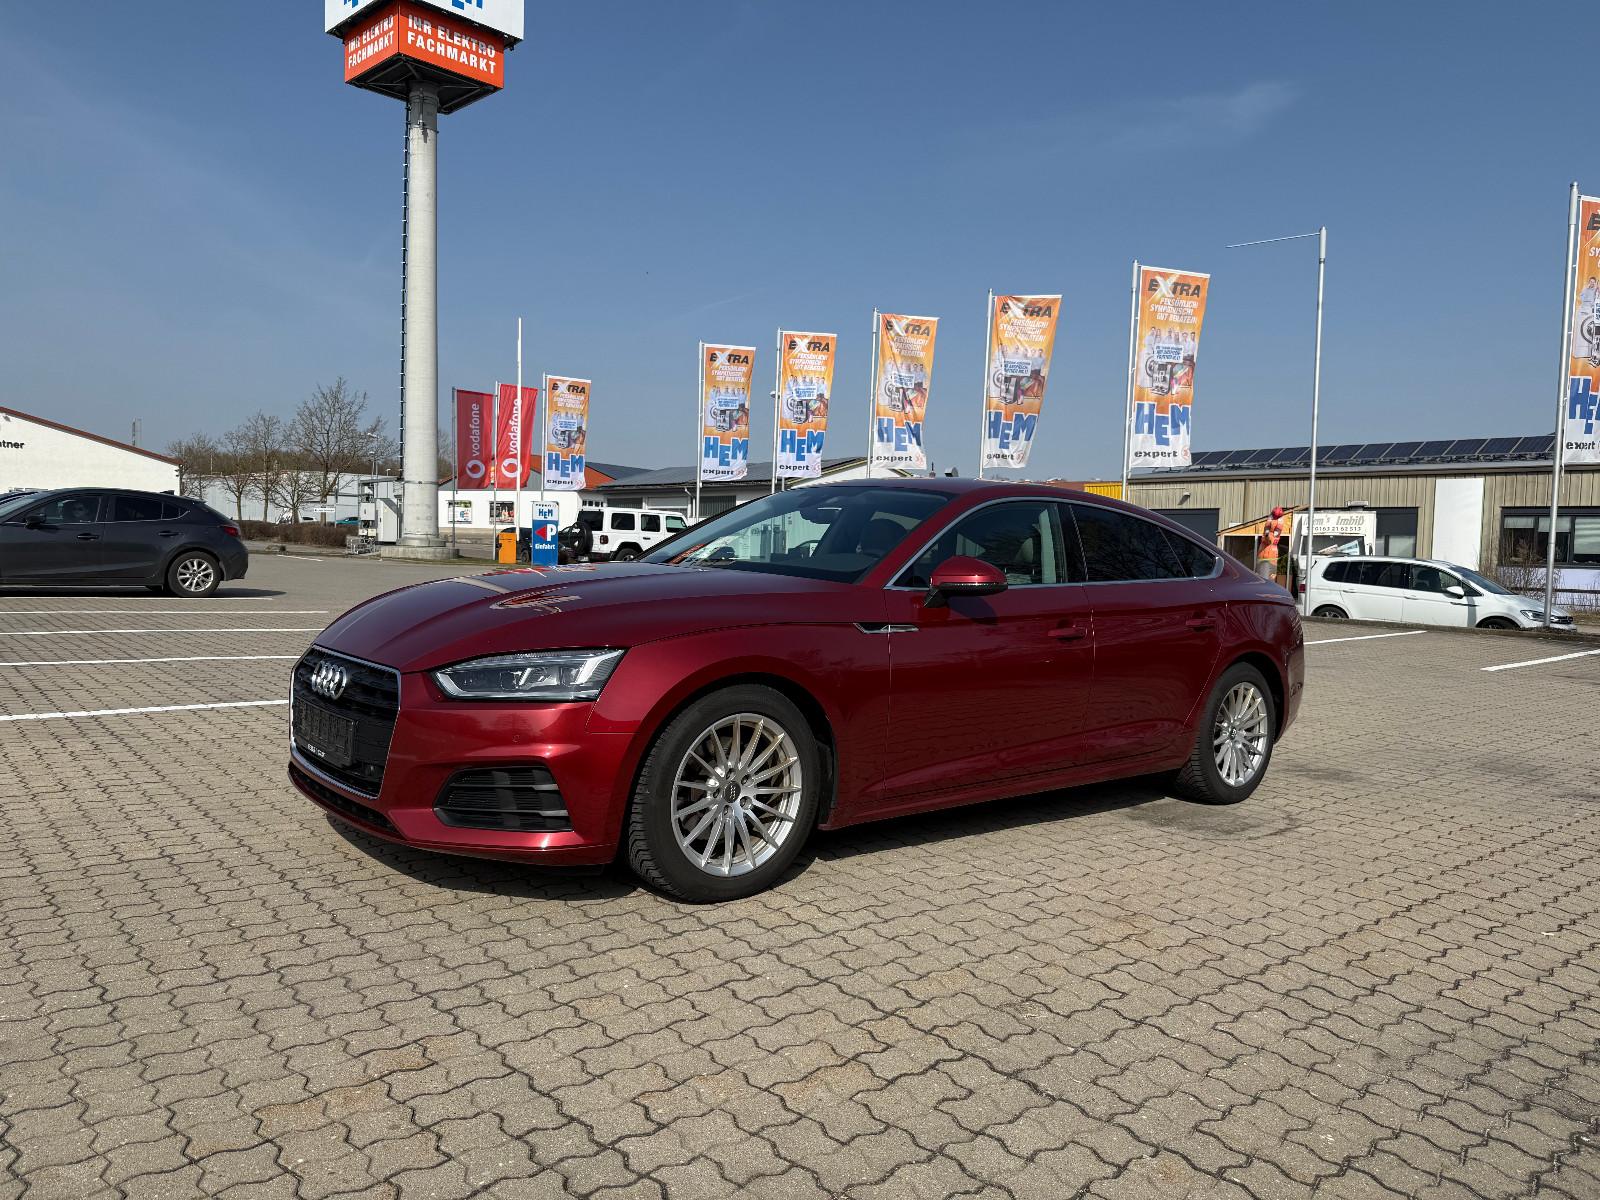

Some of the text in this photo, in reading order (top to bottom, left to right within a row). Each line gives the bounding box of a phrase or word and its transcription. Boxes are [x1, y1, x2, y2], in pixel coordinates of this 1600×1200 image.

[348, 14, 394, 54] IHR ELEKTRO
[408, 14, 496, 59] IHR ELEKTRO
[348, 30, 394, 70] FACHMARKT
[407, 31, 496, 74] FACHMARKT
[1147, 275, 1201, 298] EXTRA
[709, 351, 749, 365] EXTRA
[788, 338, 830, 353] EXTRA
[551, 382, 586, 395] EXTRA
[469, 403, 480, 457] vodafone
[988, 411, 1038, 449] HEM
[1135, 403, 1190, 446] HEM
[704, 436, 749, 466] HEM
[780, 429, 825, 462] HEM
[1134, 450, 1178, 459] expert
[547, 452, 584, 478] HEM
[703, 468, 734, 476] expert
[538, 508, 553, 519] HEM
[546, 523, 557, 542] P
